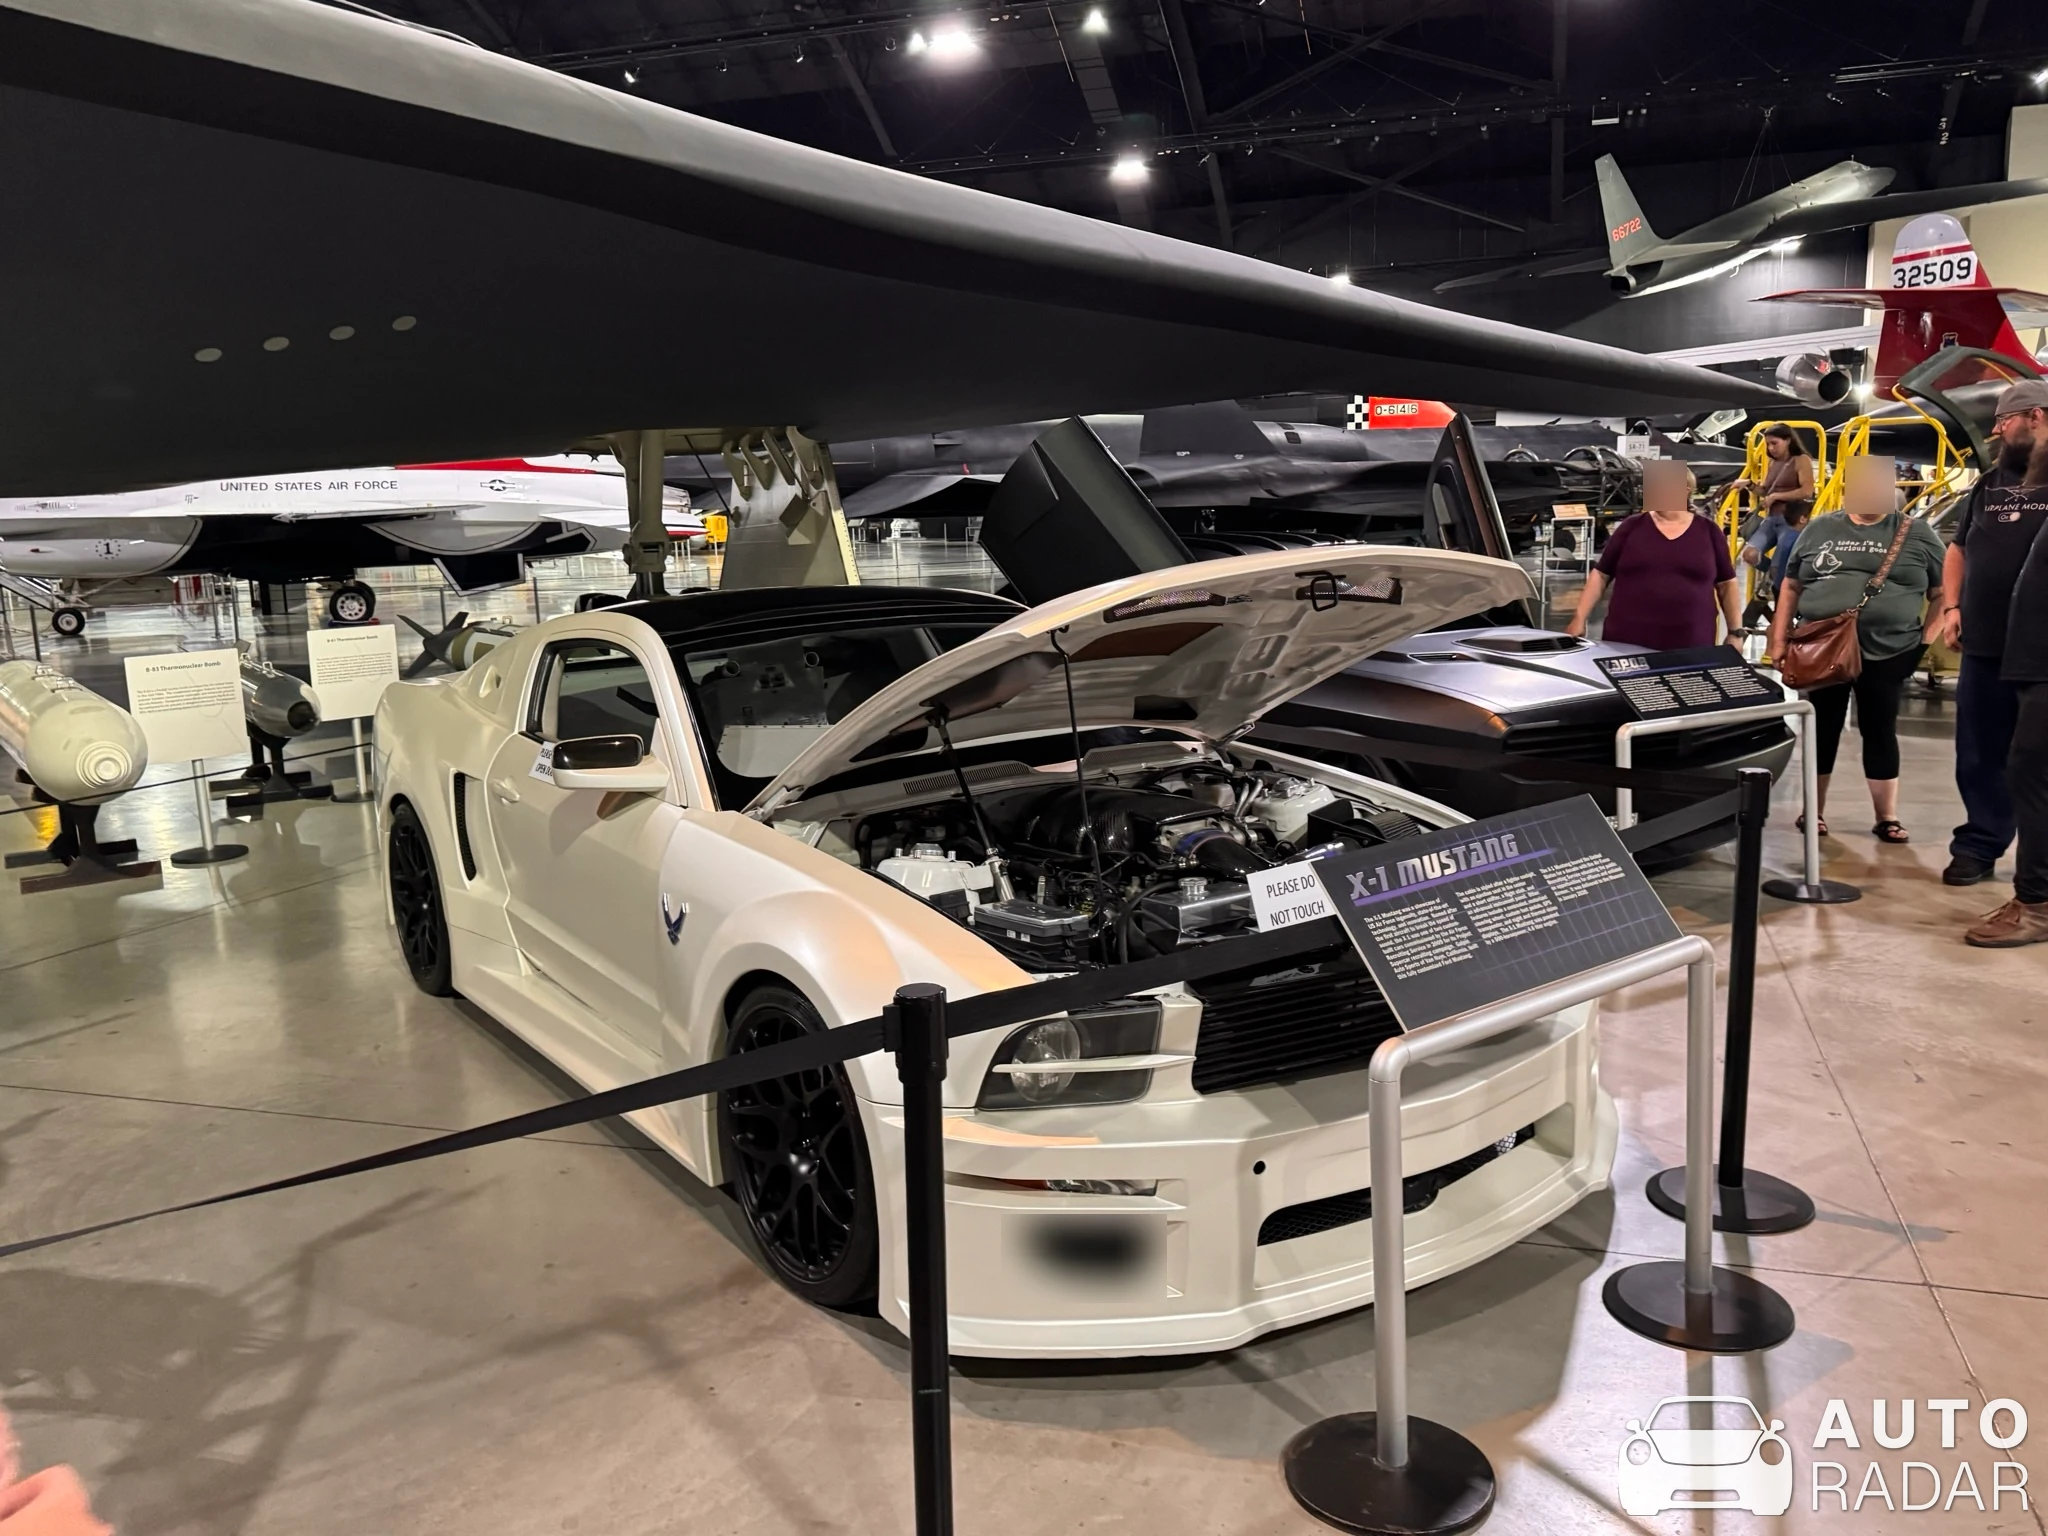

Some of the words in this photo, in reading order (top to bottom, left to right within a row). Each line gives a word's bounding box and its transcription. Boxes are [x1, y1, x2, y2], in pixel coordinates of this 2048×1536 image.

[1612, 218, 1641, 241] 66722
[1893, 257, 1971, 288] 32509
[220, 482, 268, 491] UNITED
[275, 481, 322, 491] STATES
[328, 481, 349, 490] AIR
[354, 480, 399, 490] FORCE
[103, 542, 114, 555] 1
[160, 662, 203, 671] Thermonuclear
[204, 660, 221, 668] Bomb
[1345, 866, 1390, 900] X-1
[1396, 834, 1519, 887] MUSTANG
[1266, 878, 1300, 898] PLEASE
[1300, 874, 1316, 889] DO
[1269, 907, 1293, 927] NOT
[1291, 900, 1325, 920] TOUCH
